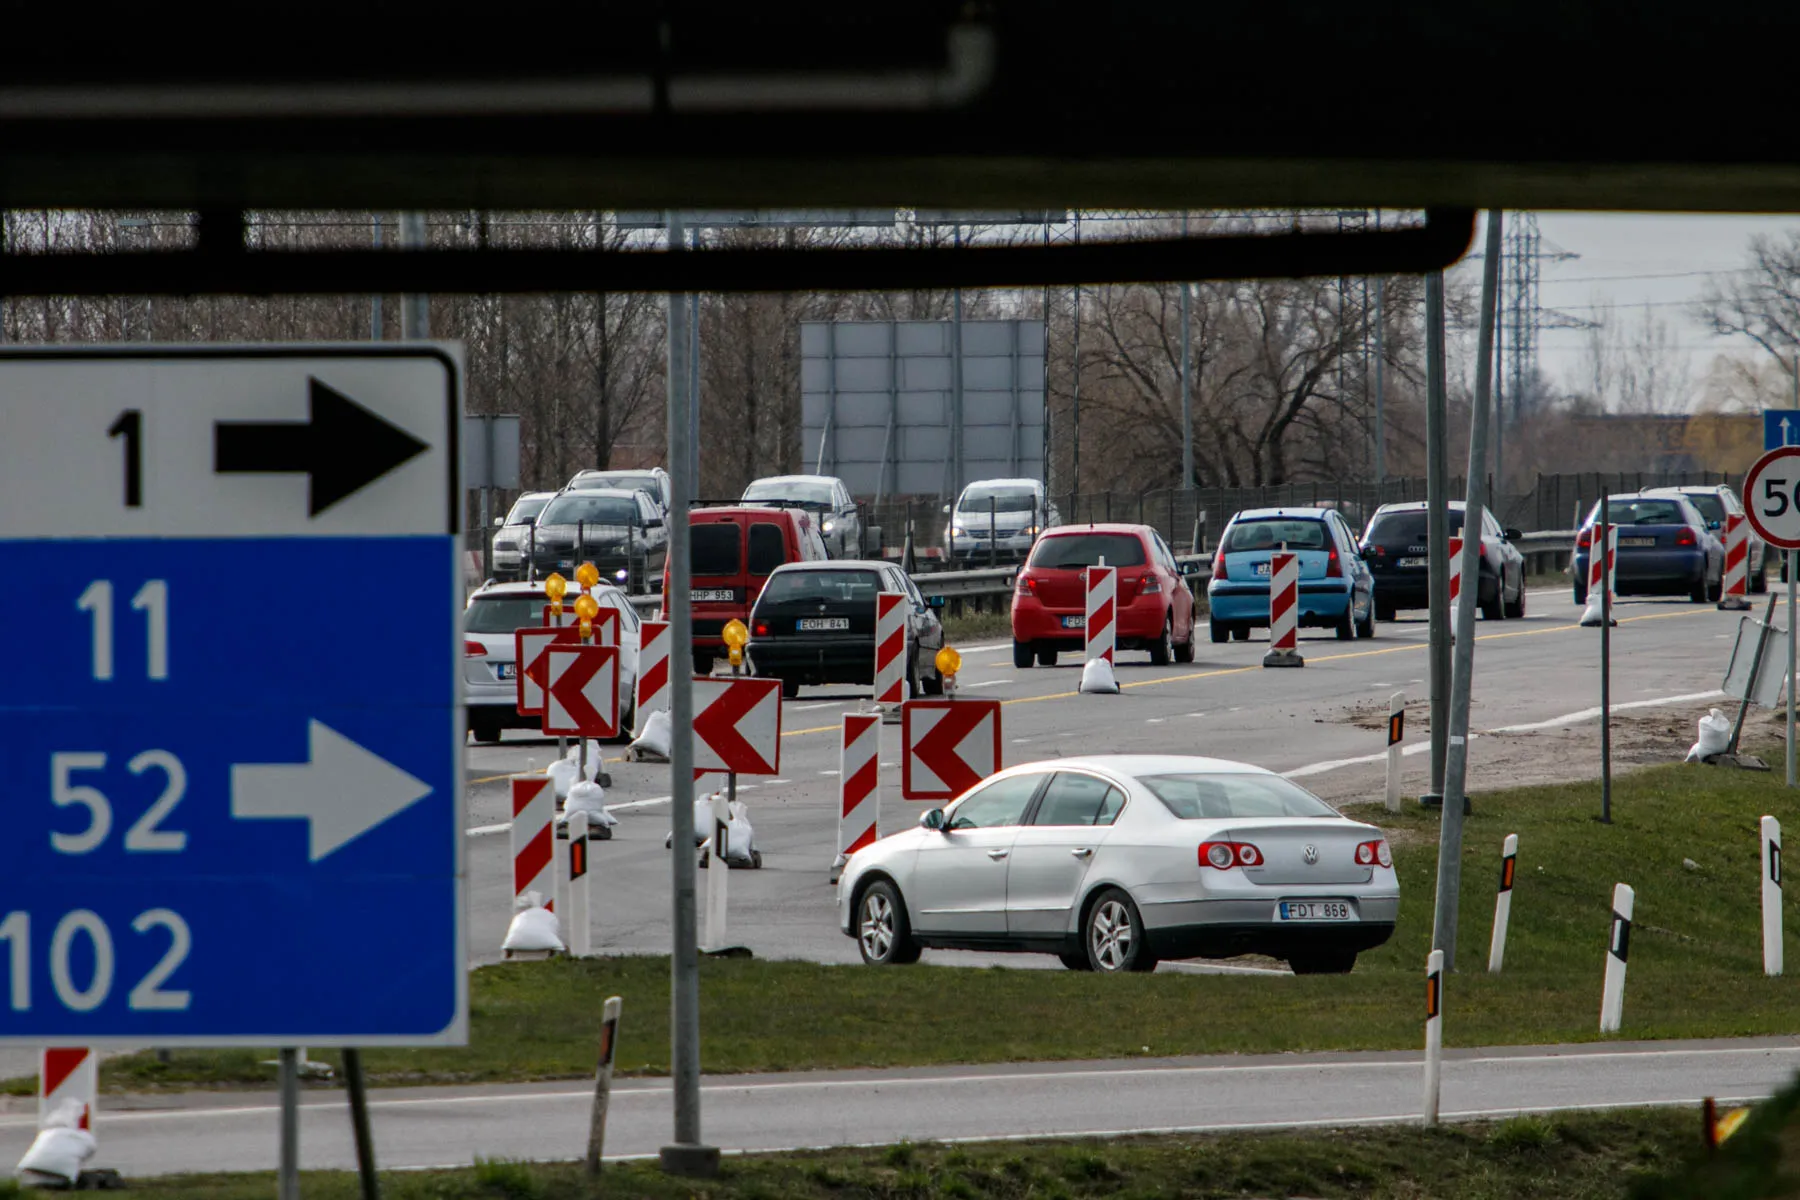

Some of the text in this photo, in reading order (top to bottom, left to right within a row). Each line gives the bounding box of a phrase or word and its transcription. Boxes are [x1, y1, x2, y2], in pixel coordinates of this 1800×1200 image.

[108, 409, 142, 508] 1
[1763, 478, 1800, 517] 5
[77, 579, 168, 680] 11
[715, 590, 732, 600] 953
[50, 750, 187, 854] 52
[1289, 903, 1316, 917] FDT
[0, 909, 192, 1011] 102
